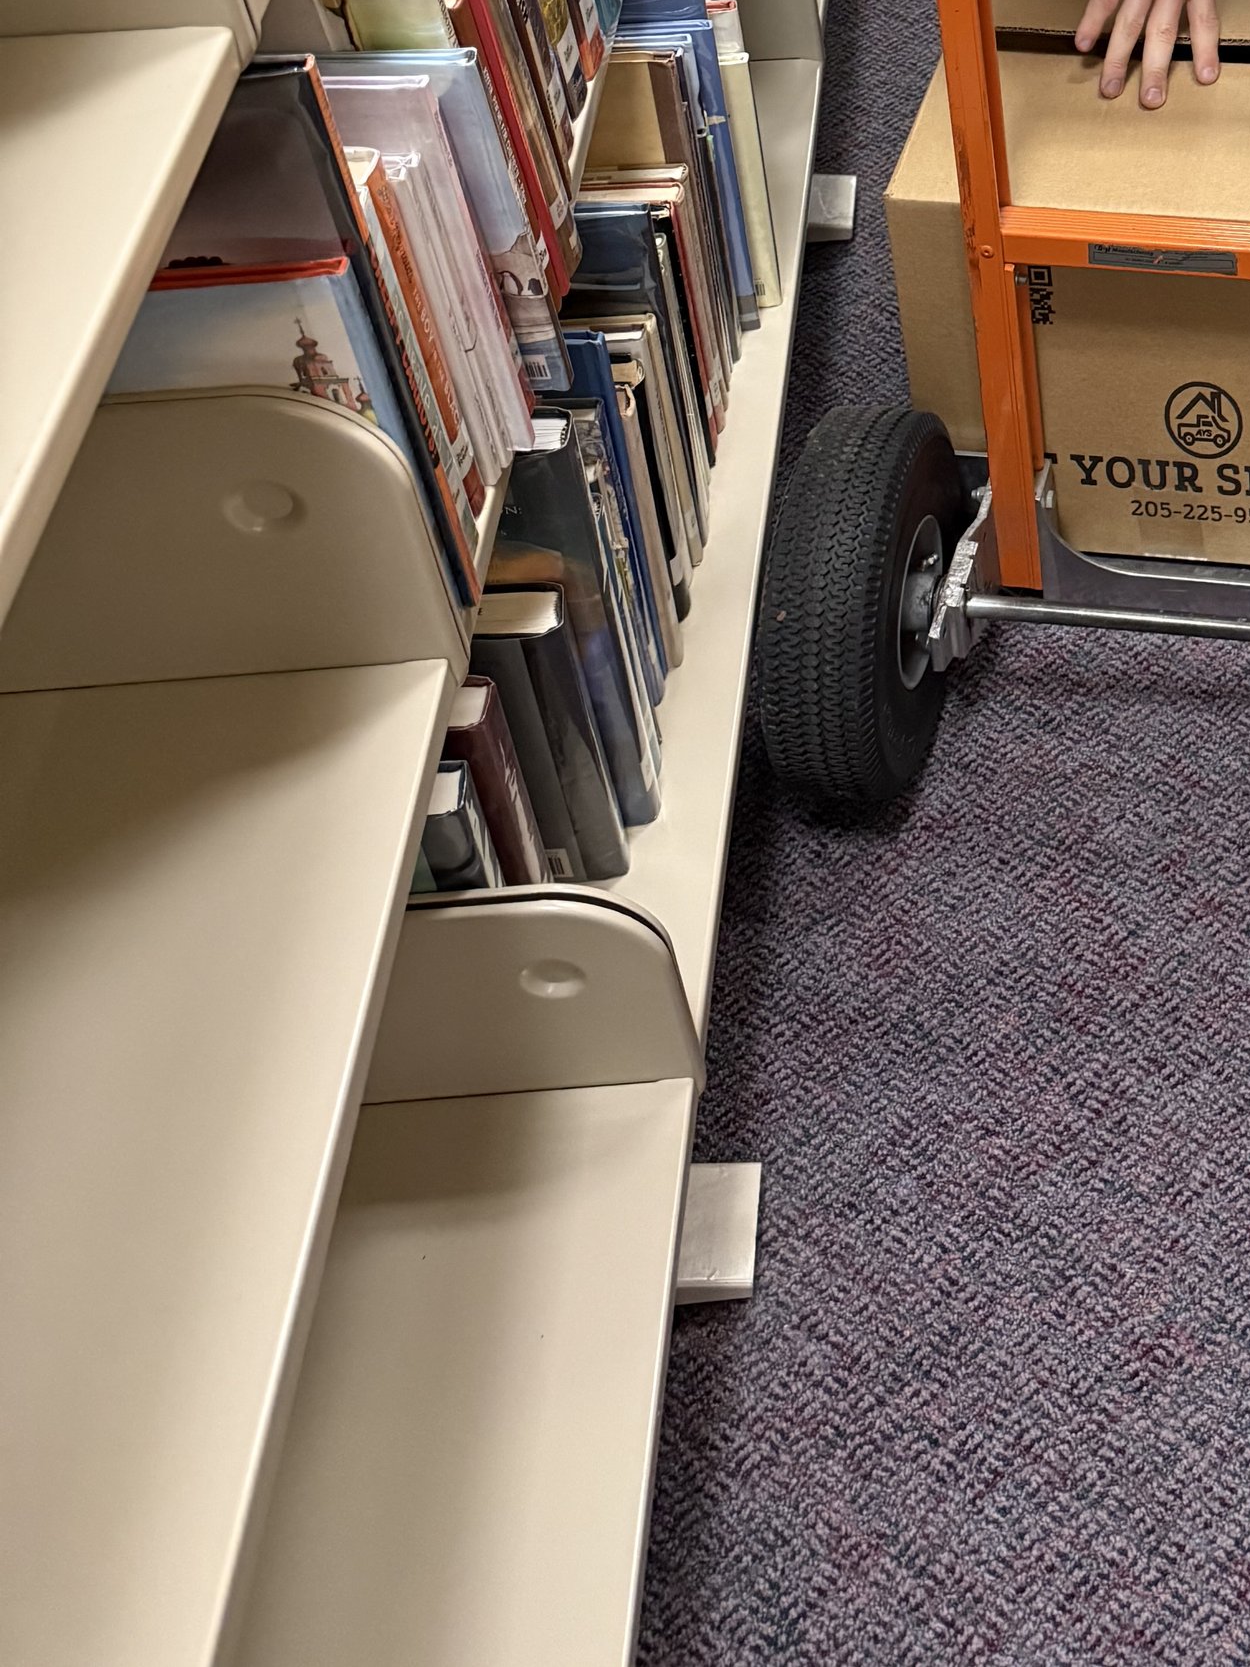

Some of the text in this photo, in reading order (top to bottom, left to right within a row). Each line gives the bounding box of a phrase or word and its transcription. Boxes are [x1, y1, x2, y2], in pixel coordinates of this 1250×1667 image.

[420, 307, 434, 343] BOY
[1195, 428, 1213, 438] AYS
[1070, 453, 1203, 493] YOUR
